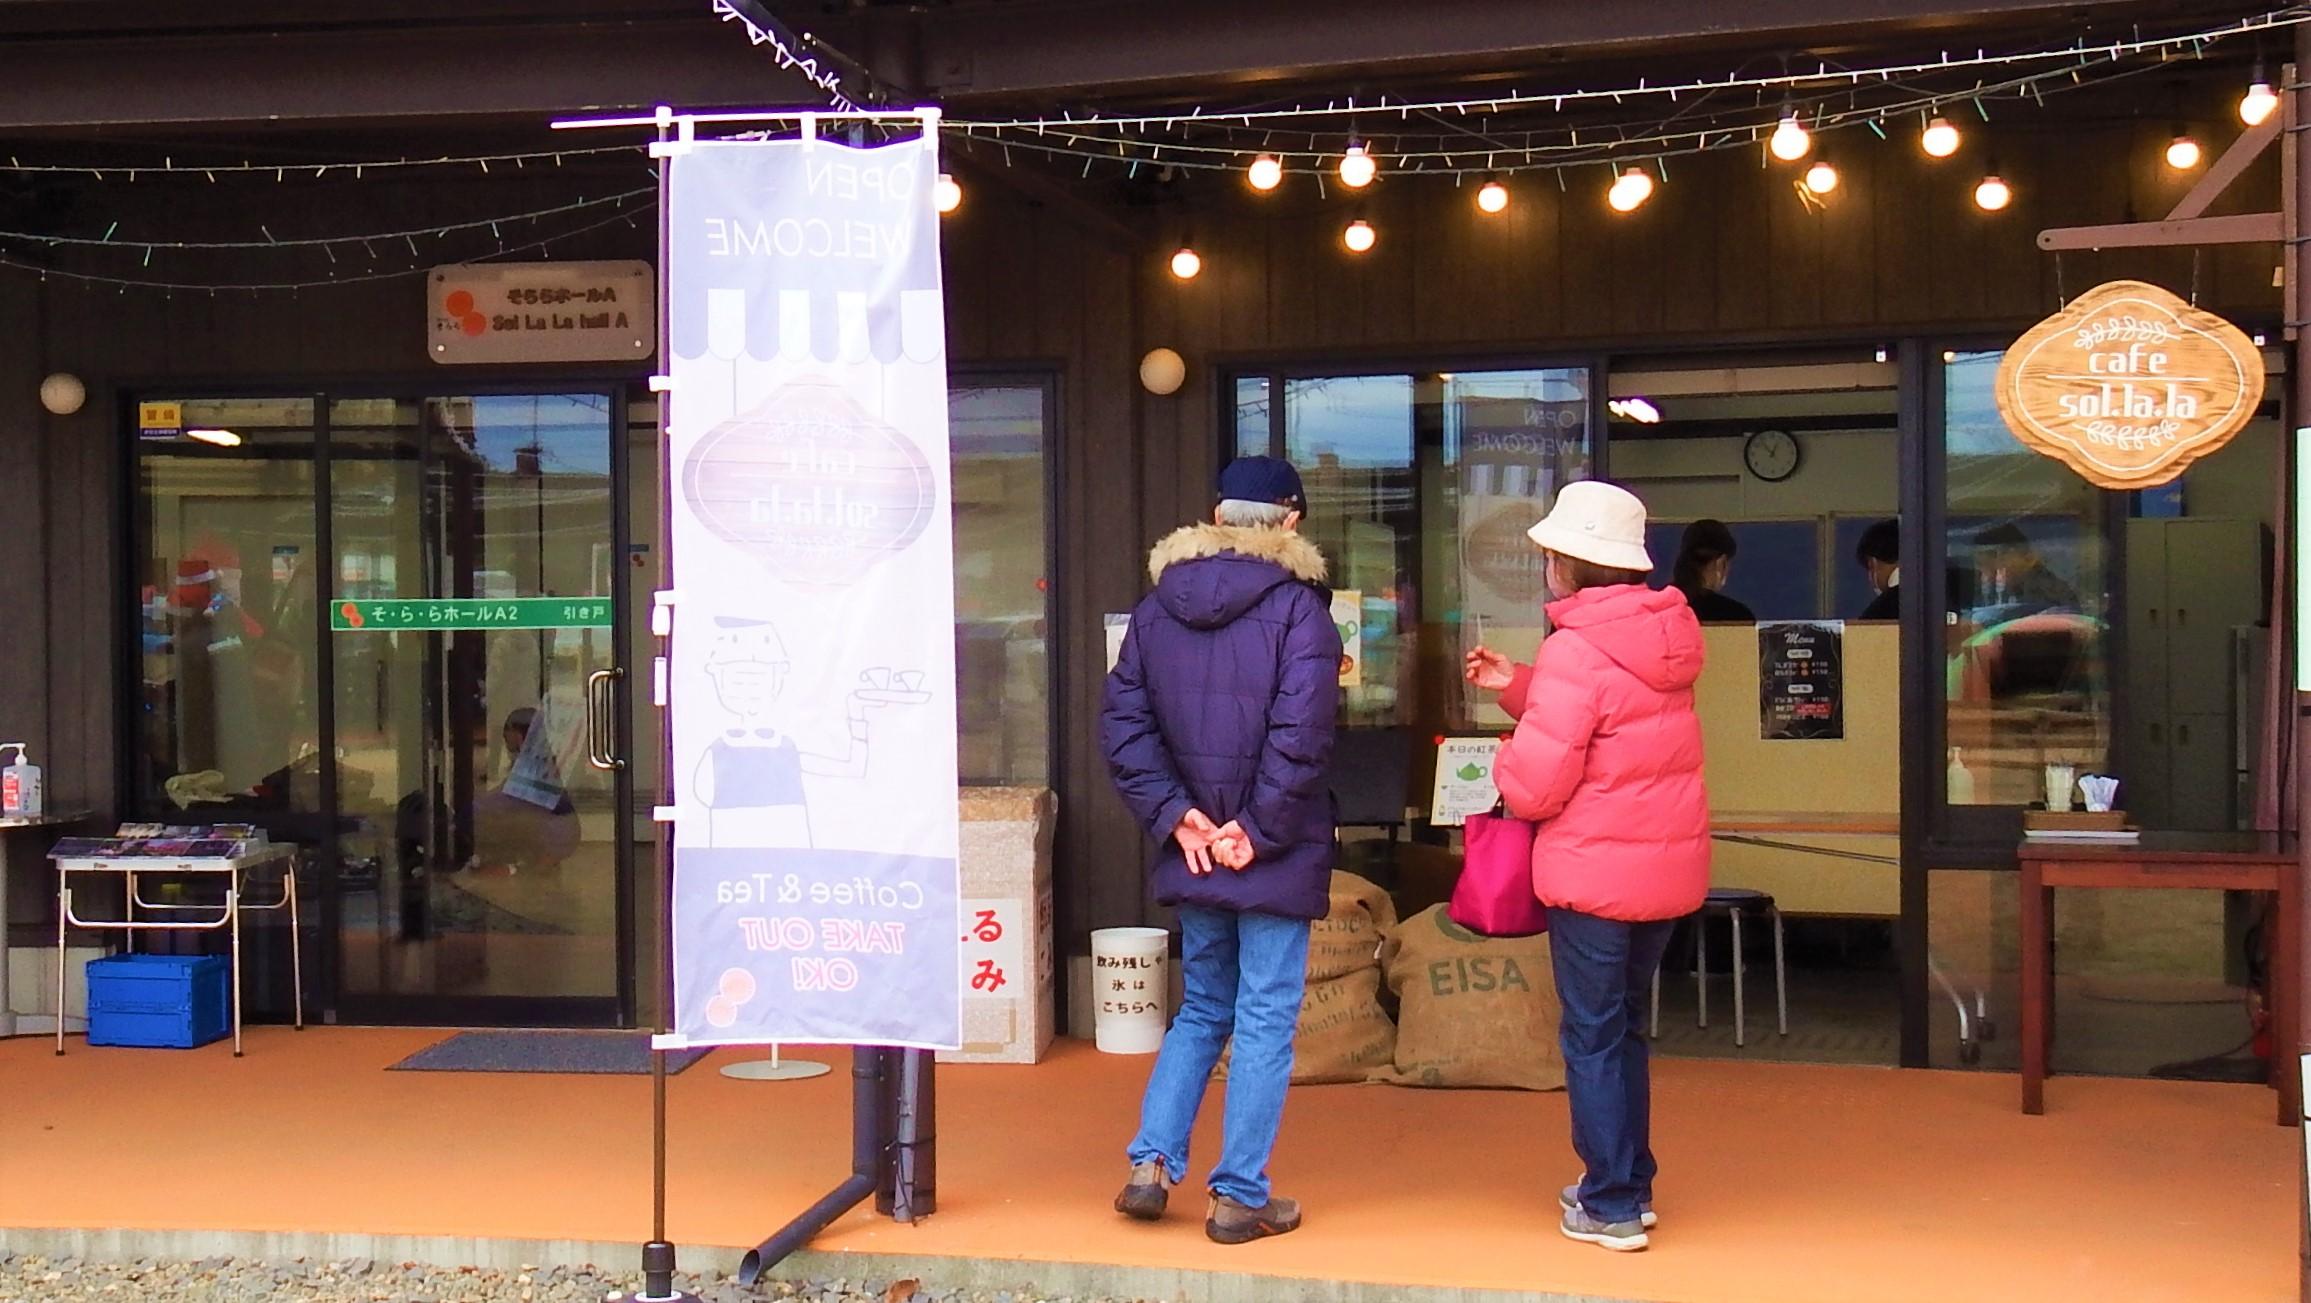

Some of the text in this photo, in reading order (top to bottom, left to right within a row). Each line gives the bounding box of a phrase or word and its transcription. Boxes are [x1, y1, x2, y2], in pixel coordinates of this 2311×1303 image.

[615, 312, 629, 328] A
[2088, 343, 2168, 374] cafe
[2058, 383, 2197, 418] sol.la.la
[563, 605, 605, 620] 引き戸
[961, 910, 1002, 942] る
[1428, 957, 1530, 996] EISA
[1103, 1001, 1158, 1014] こちらへ
